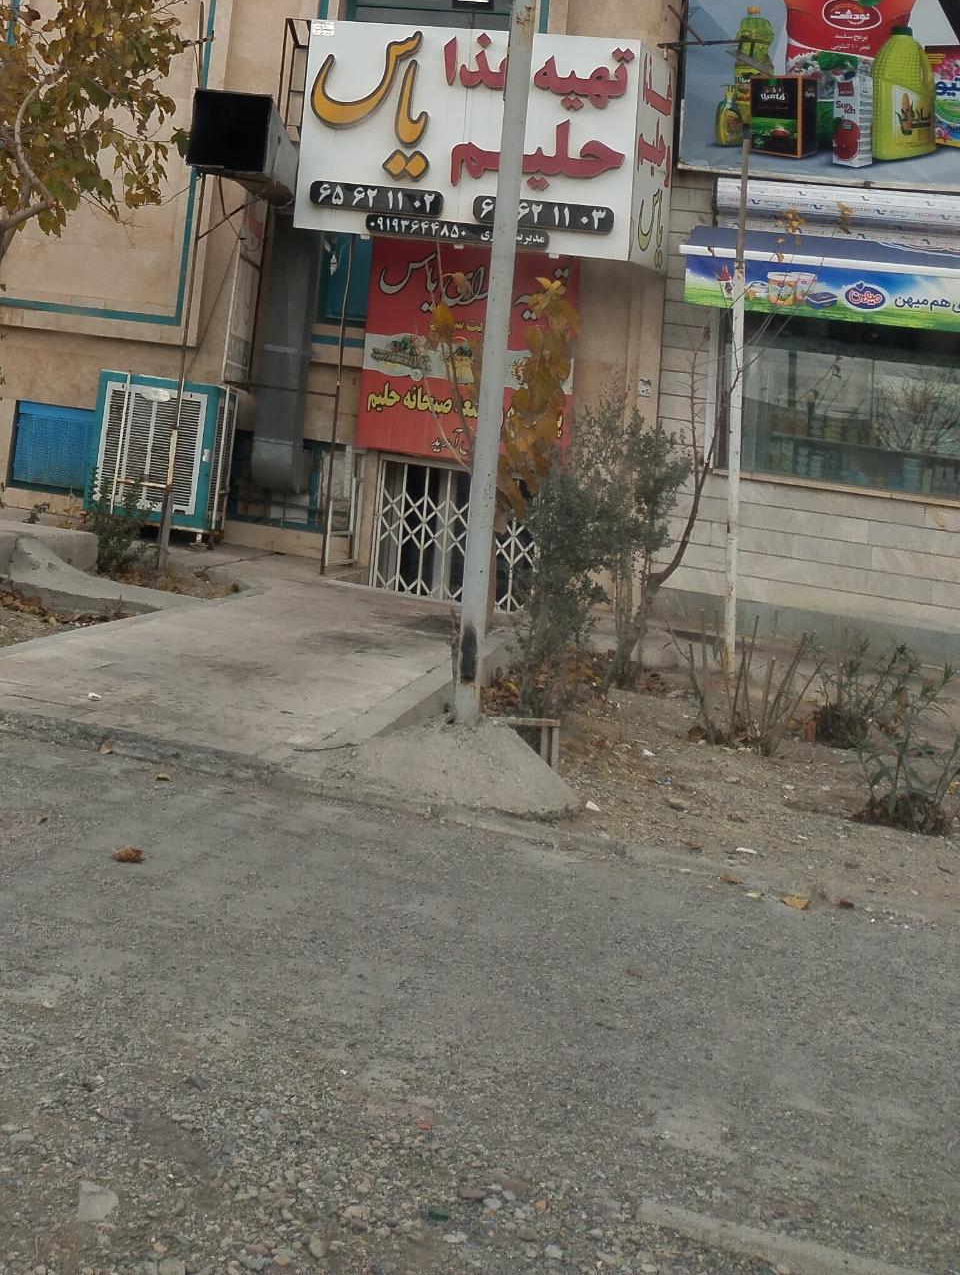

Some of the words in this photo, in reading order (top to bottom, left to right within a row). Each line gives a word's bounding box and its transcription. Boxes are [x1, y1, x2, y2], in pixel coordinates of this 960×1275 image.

[533, 47, 635, 110] تهیه
[311, 30, 430, 181] یاس
[450, 119, 626, 192] حلیم
[318, 184, 344, 205] ۶۵
[352, 187, 378, 208] ۶۲
[387, 190, 403, 211] ۱۱
[413, 193, 435, 213] ۰۲
[517, 202, 543, 224] ۶۲
[553, 205, 570, 227] ۱۱
[581, 209, 606, 229] ۰۳
[515, 233, 545, 245] مدیری
[894, 296, 929, 309] میهن
[930, 298, 951, 311] هم
[367, 381, 401, 412] حلیم
